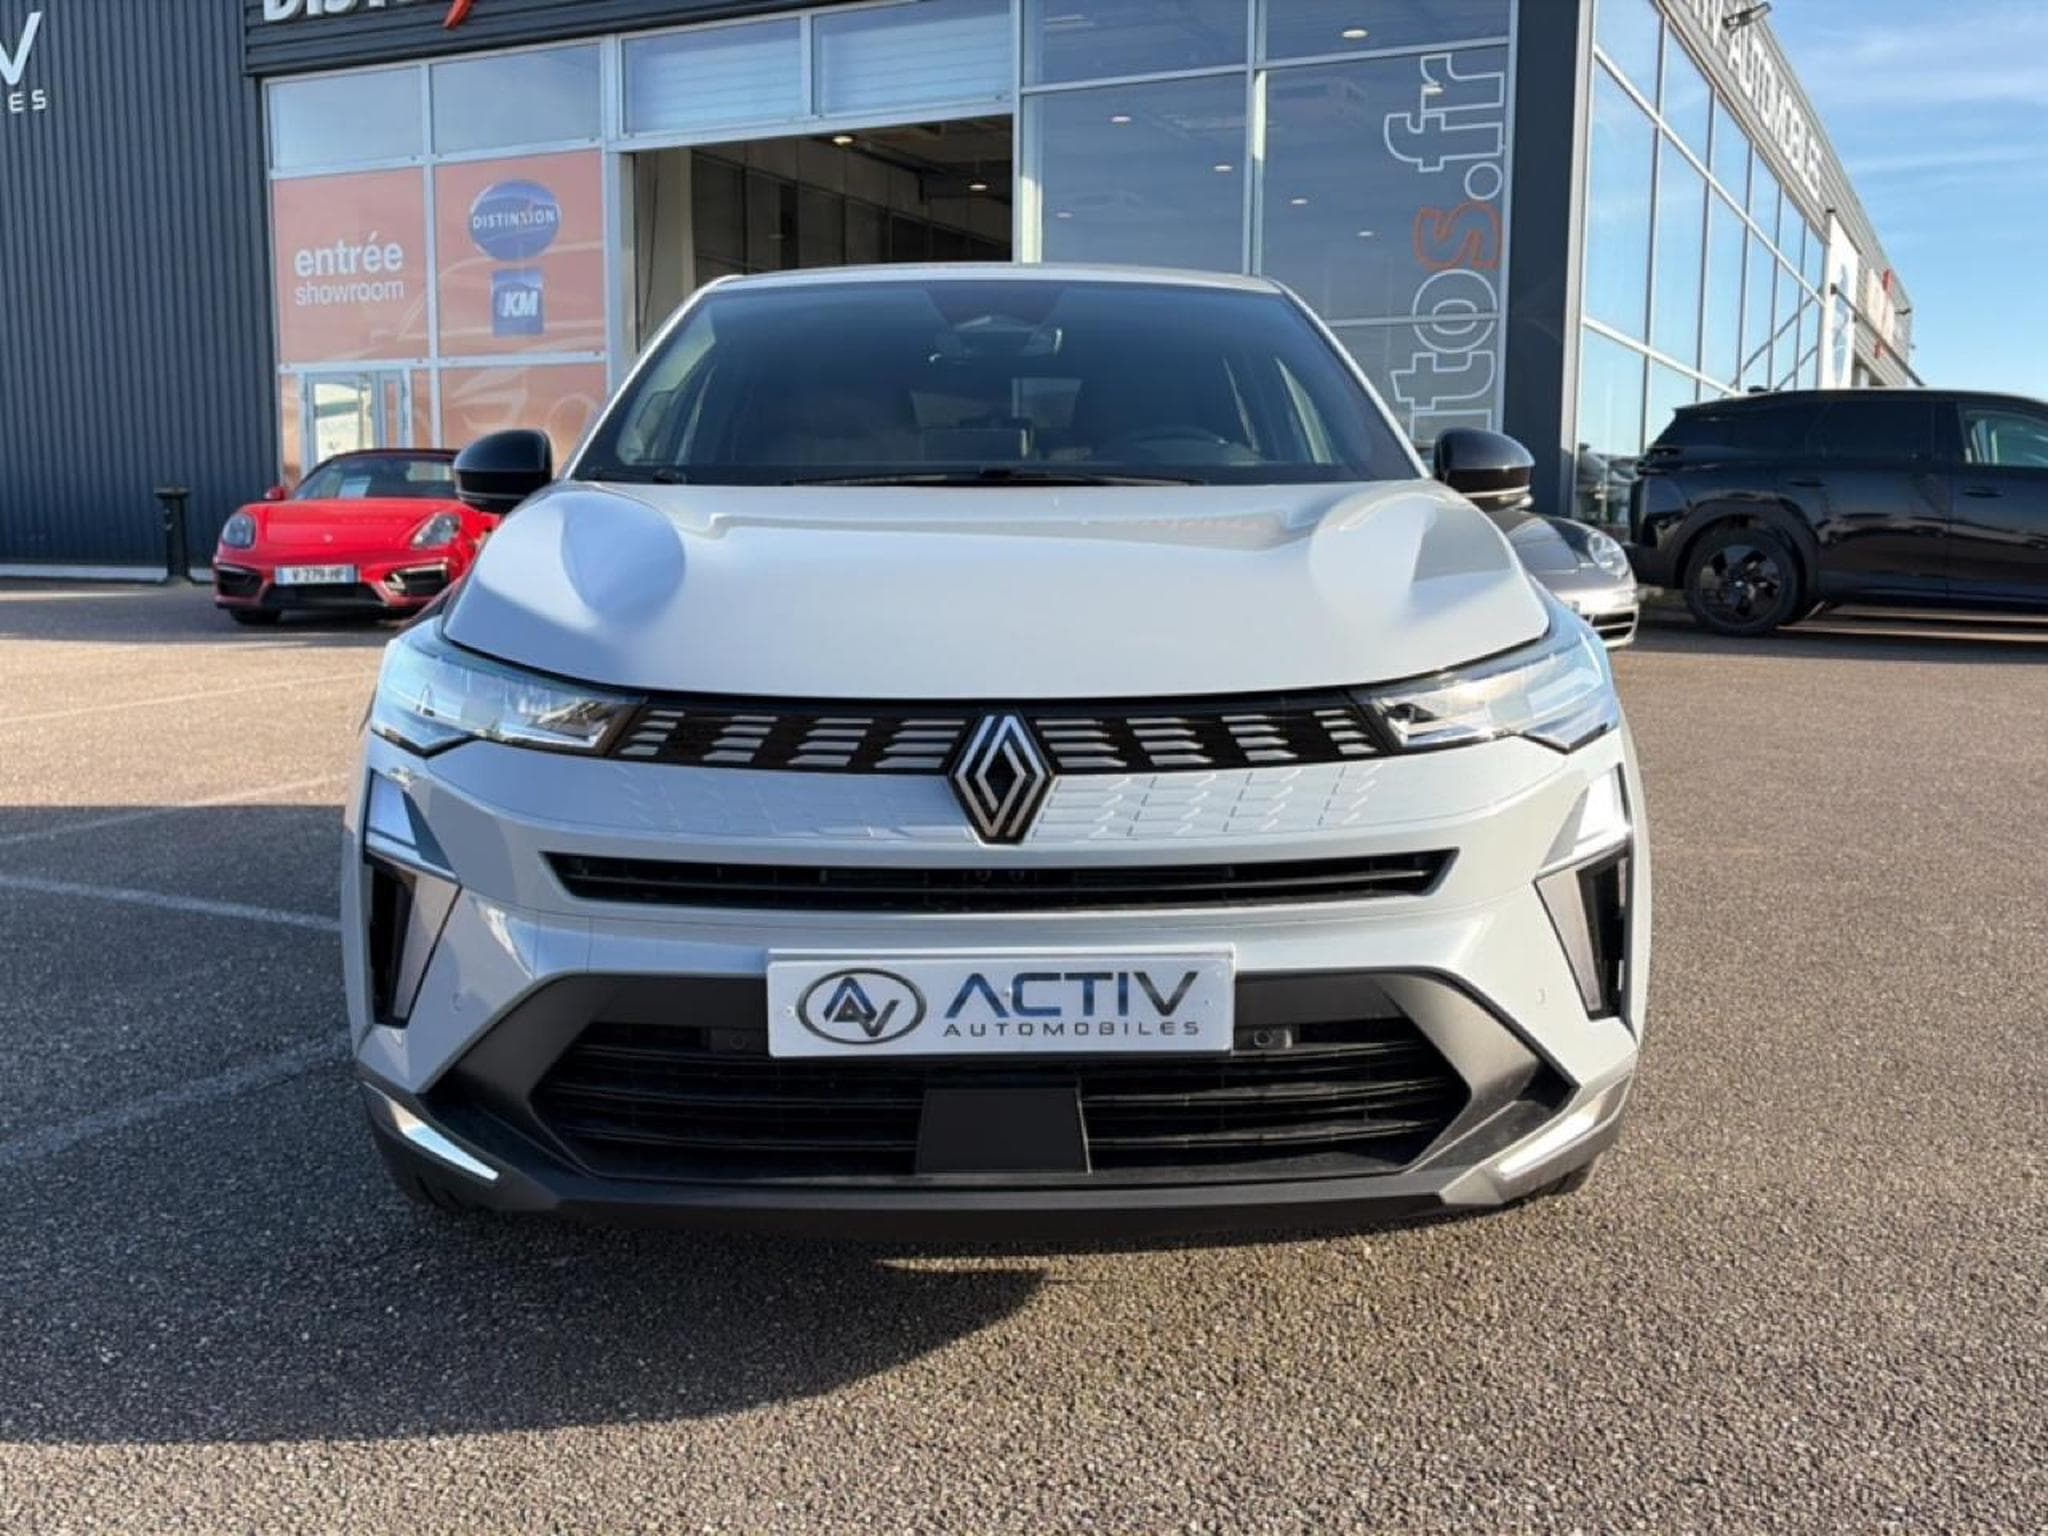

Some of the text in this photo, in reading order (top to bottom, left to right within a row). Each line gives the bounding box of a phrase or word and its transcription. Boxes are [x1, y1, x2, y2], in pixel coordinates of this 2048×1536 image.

[294, 230, 403, 278] entrée
[294, 280, 404, 306] showroom
[944, 971, 1199, 1018] ACTIV
[942, 1021, 1200, 1038] AUTOMOBILES
